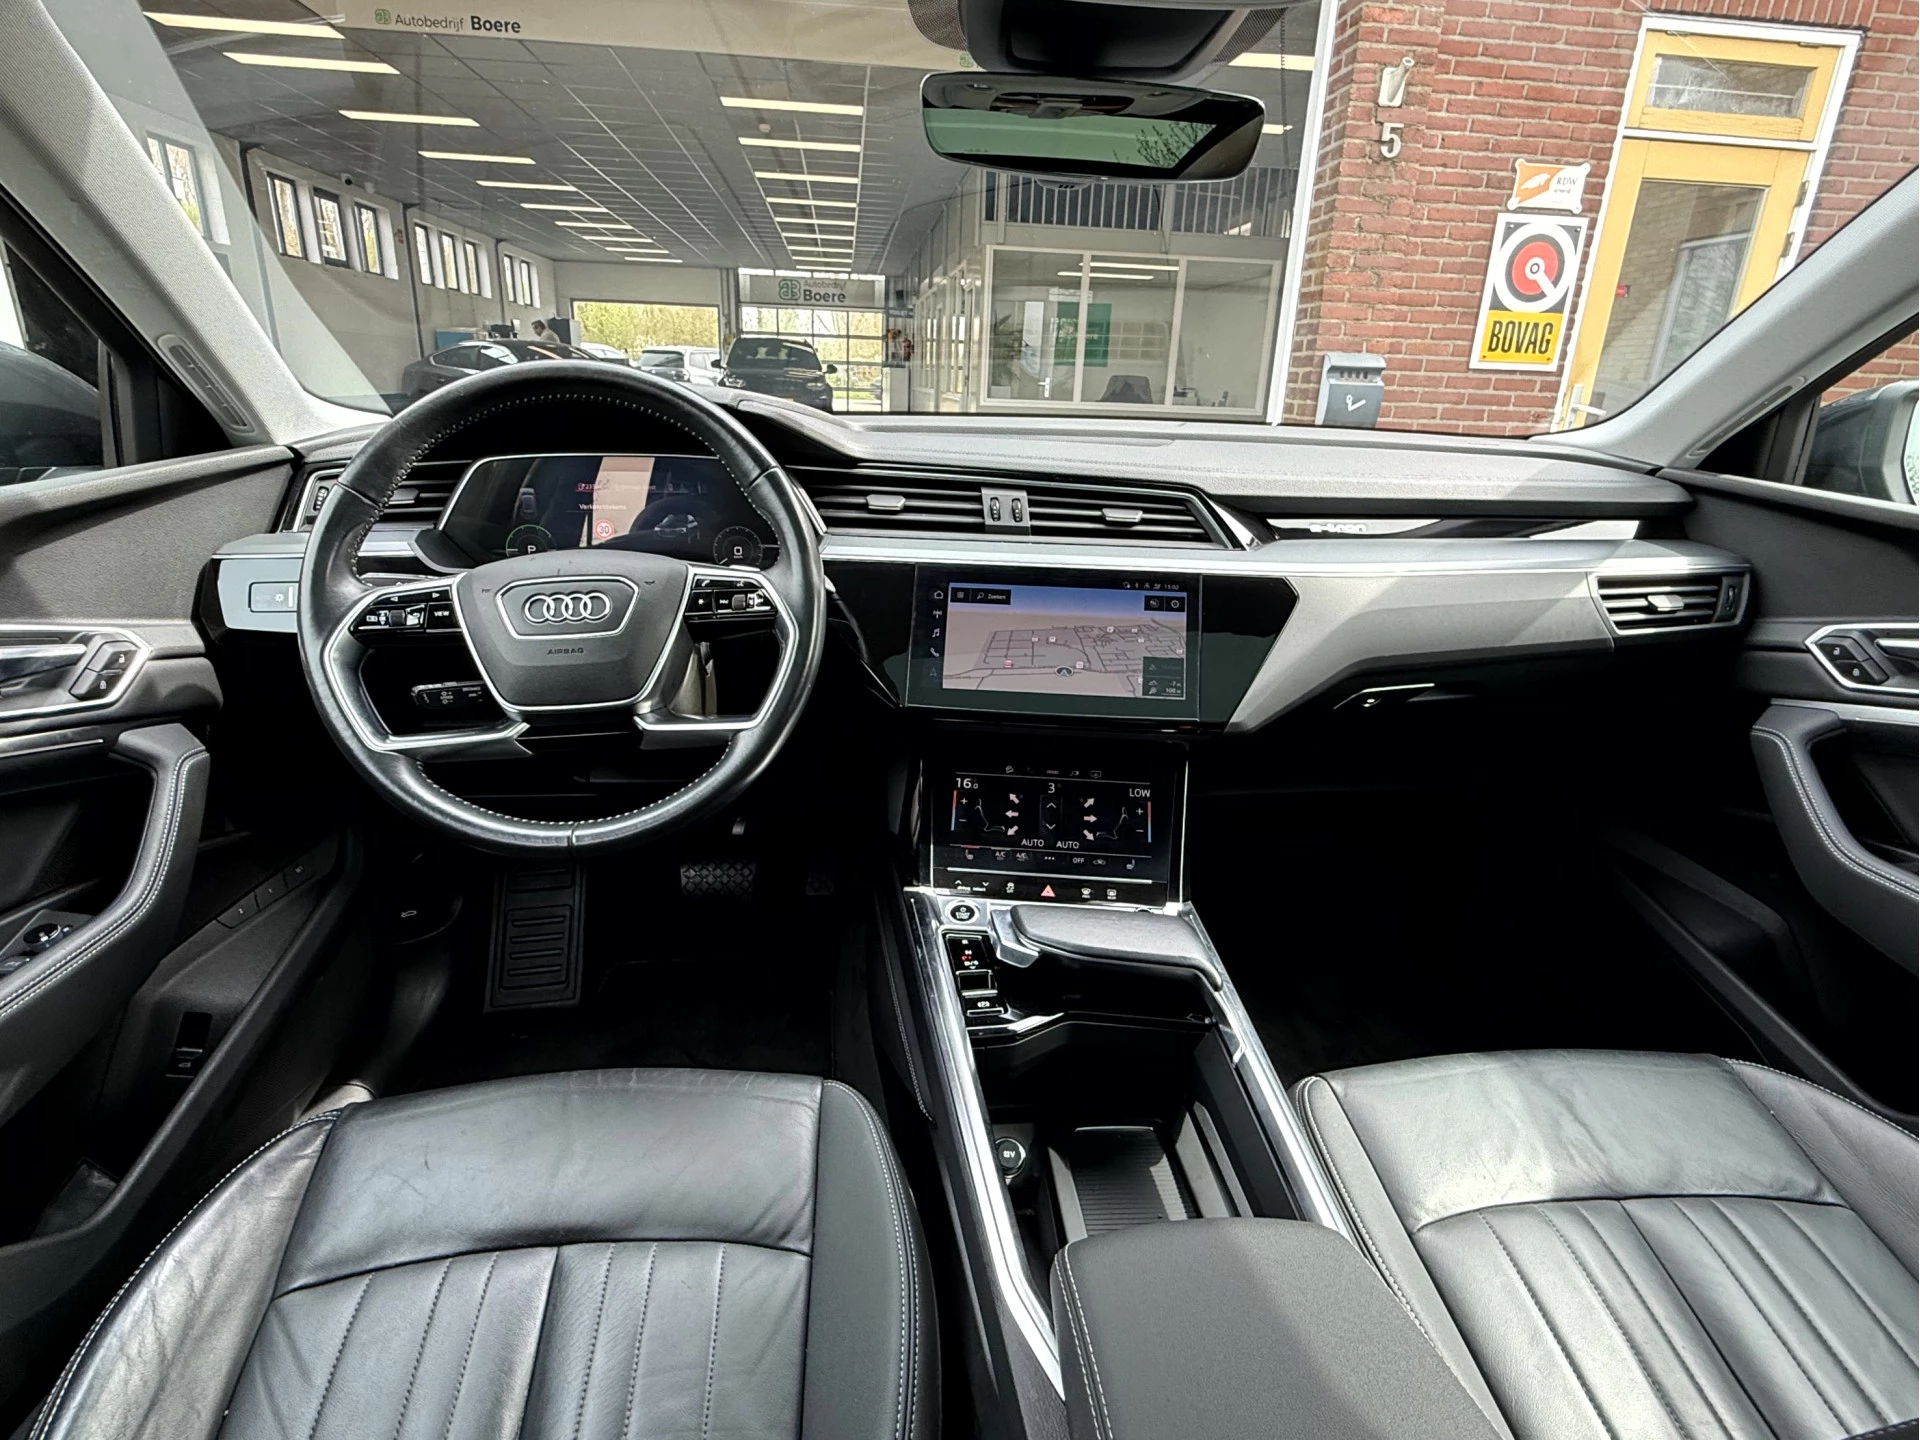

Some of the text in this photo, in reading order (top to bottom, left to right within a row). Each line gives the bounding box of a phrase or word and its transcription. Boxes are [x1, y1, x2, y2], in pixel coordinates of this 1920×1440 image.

[395, 14, 521, 34] Autobedrijf Boere
[1380, 122, 1404, 158] 5
[1556, 177, 1578, 186] RDW
[803, 289, 847, 303] Boere
[1488, 320, 1554, 355] BOVAG
[599, 525, 610, 534] 30
[528, 545, 537, 554] P
[547, 647, 584, 655] AIRBAG
[1047, 783, 1055, 793] 3
[1129, 788, 1151, 798] LOW
[1021, 839, 1044, 847] AUTO
[1056, 841, 1080, 849] AUTO
